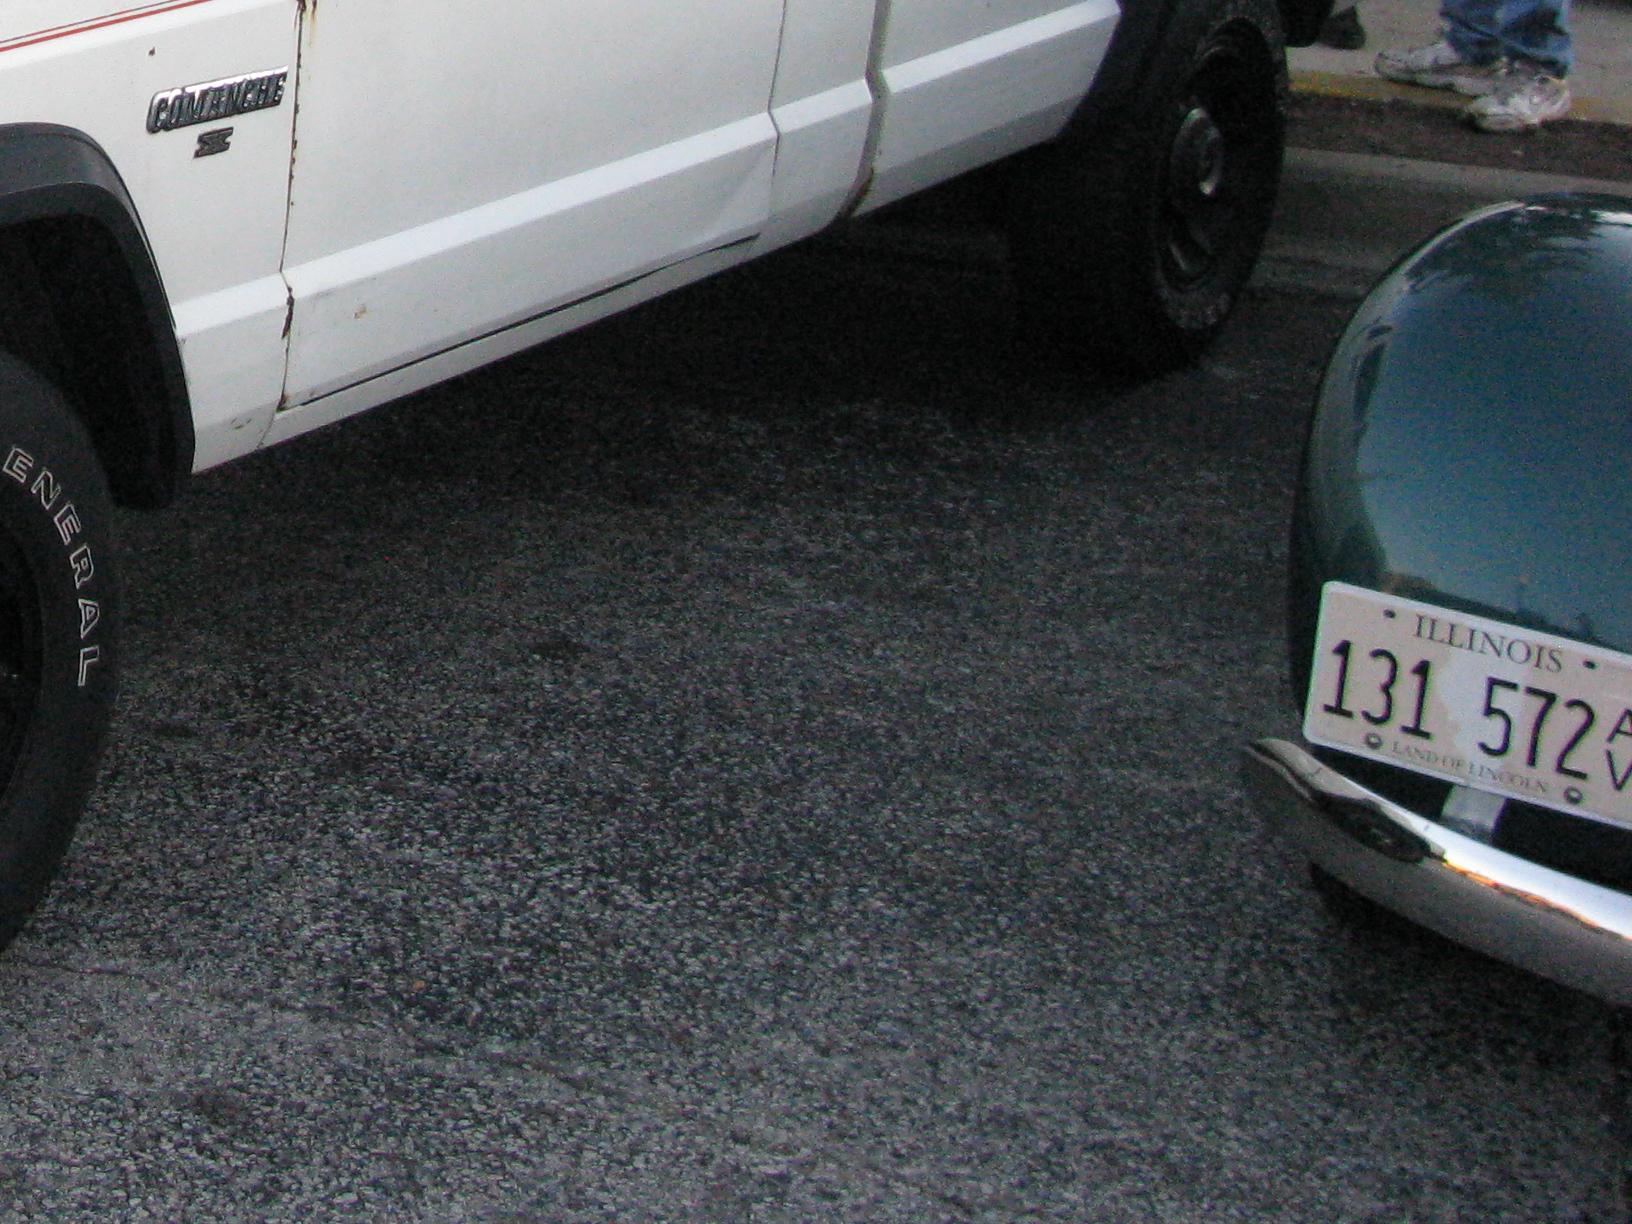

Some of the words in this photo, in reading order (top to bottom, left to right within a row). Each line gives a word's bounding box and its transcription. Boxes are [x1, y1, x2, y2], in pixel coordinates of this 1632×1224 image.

[146, 65, 289, 134] COMANCHE
[1413, 613, 1565, 674] ILLINOIS
[1323, 638, 1433, 740] 131
[1477, 676, 1596, 781] 572
